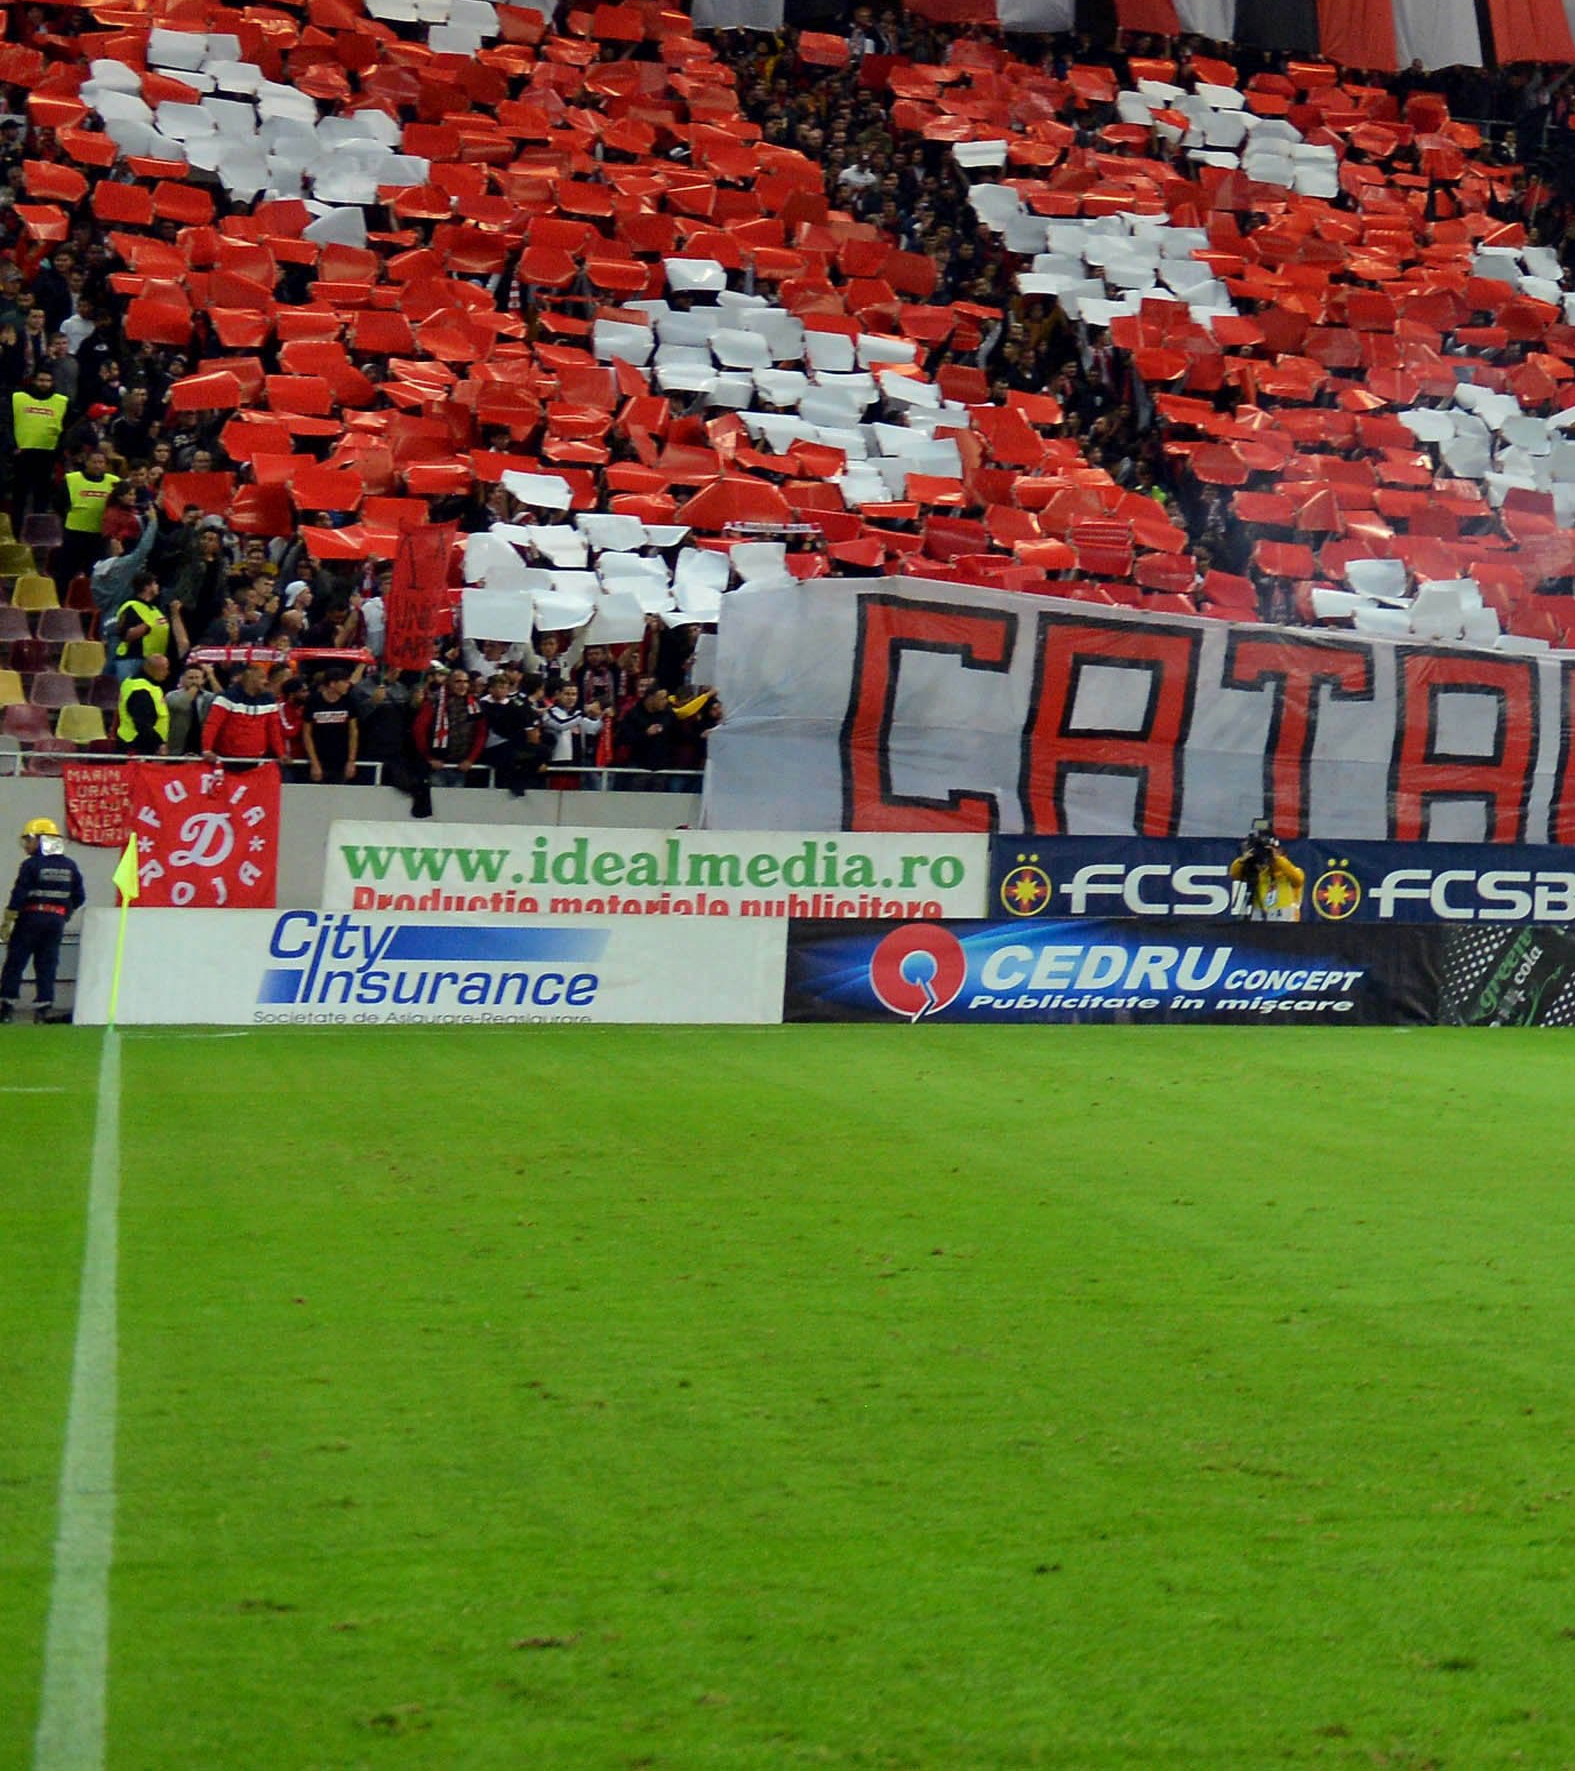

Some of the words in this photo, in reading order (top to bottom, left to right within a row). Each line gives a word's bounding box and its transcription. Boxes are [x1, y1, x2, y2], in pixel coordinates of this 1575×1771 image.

[340, 835, 965, 889] www.idealmedia.ro
[1060, 863, 1253, 916] FCS
[269, 910, 397, 975] City
[299, 968, 599, 1006] Insurance
[981, 944, 1233, 992] CEDRU
[1223, 969, 1364, 992] CONCEPT
[1513, 945, 1544, 985] cola
[254, 1010, 347, 1024] Societate
[353, 1011, 378, 1024] de
[968, 995, 1164, 1010] Publicitate
[1170, 995, 1210, 1010] în
